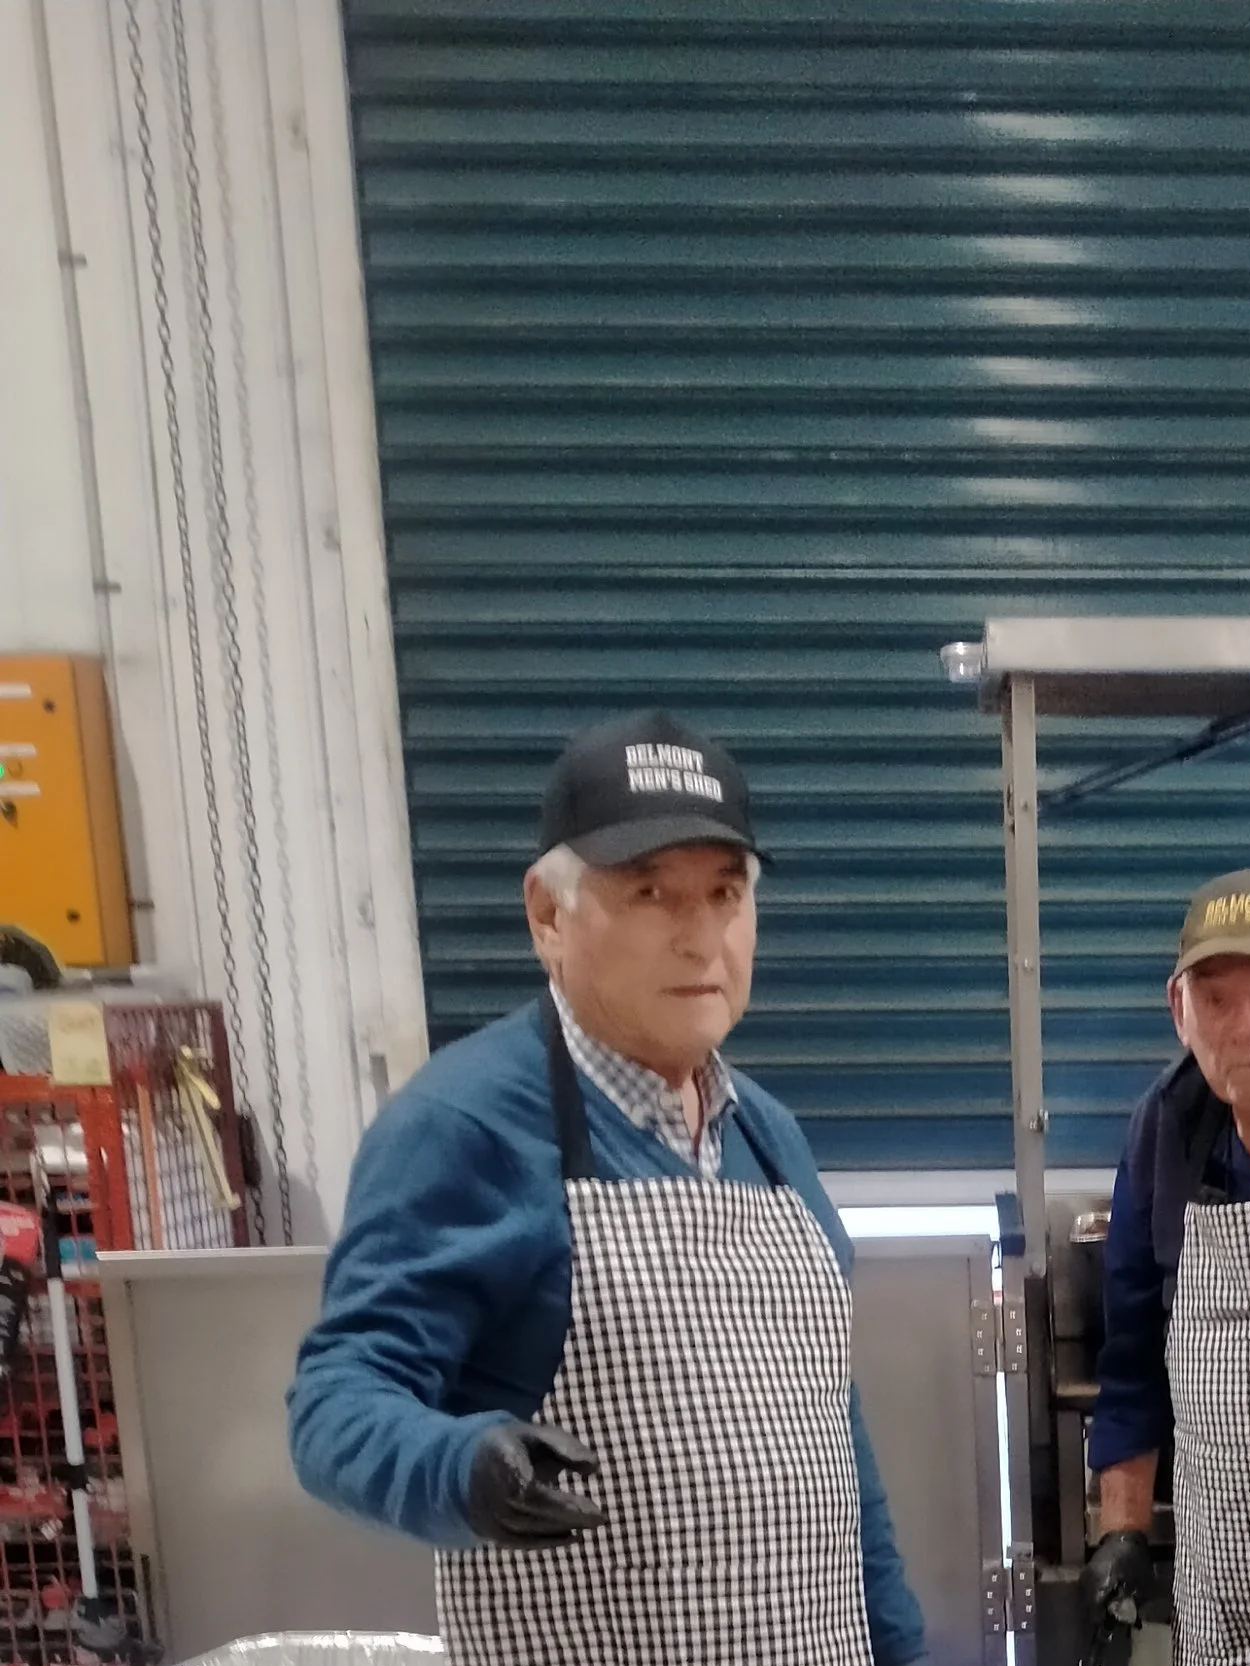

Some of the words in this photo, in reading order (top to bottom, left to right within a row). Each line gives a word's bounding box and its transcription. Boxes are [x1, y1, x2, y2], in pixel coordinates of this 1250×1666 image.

[625, 743, 704, 774] BELMONT
[627, 767, 683, 794] MEN'S
[683, 770, 724, 803] SHED
